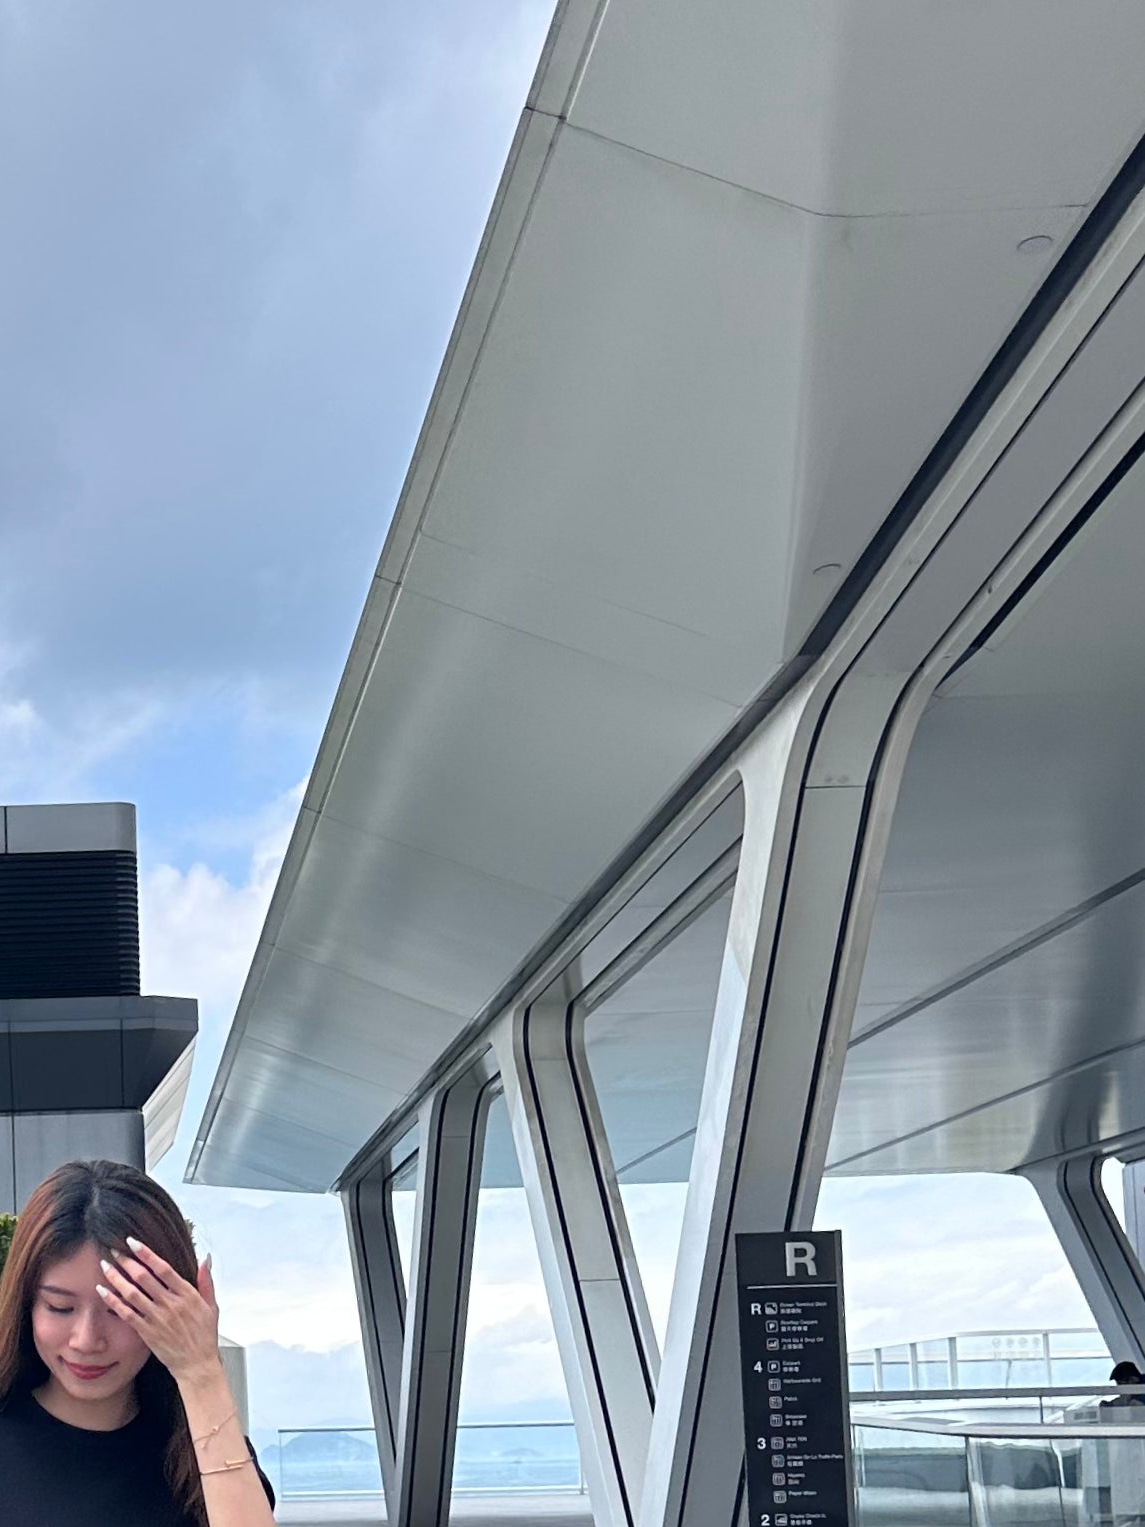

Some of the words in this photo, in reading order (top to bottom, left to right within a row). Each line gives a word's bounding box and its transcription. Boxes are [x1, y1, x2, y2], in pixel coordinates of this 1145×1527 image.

[785, 1242, 817, 1277] R
[751, 1303, 762, 1315] R
[753, 1361, 763, 1373] 4
[757, 1437, 767, 1450] 3
[760, 1514, 771, 1527] 2
